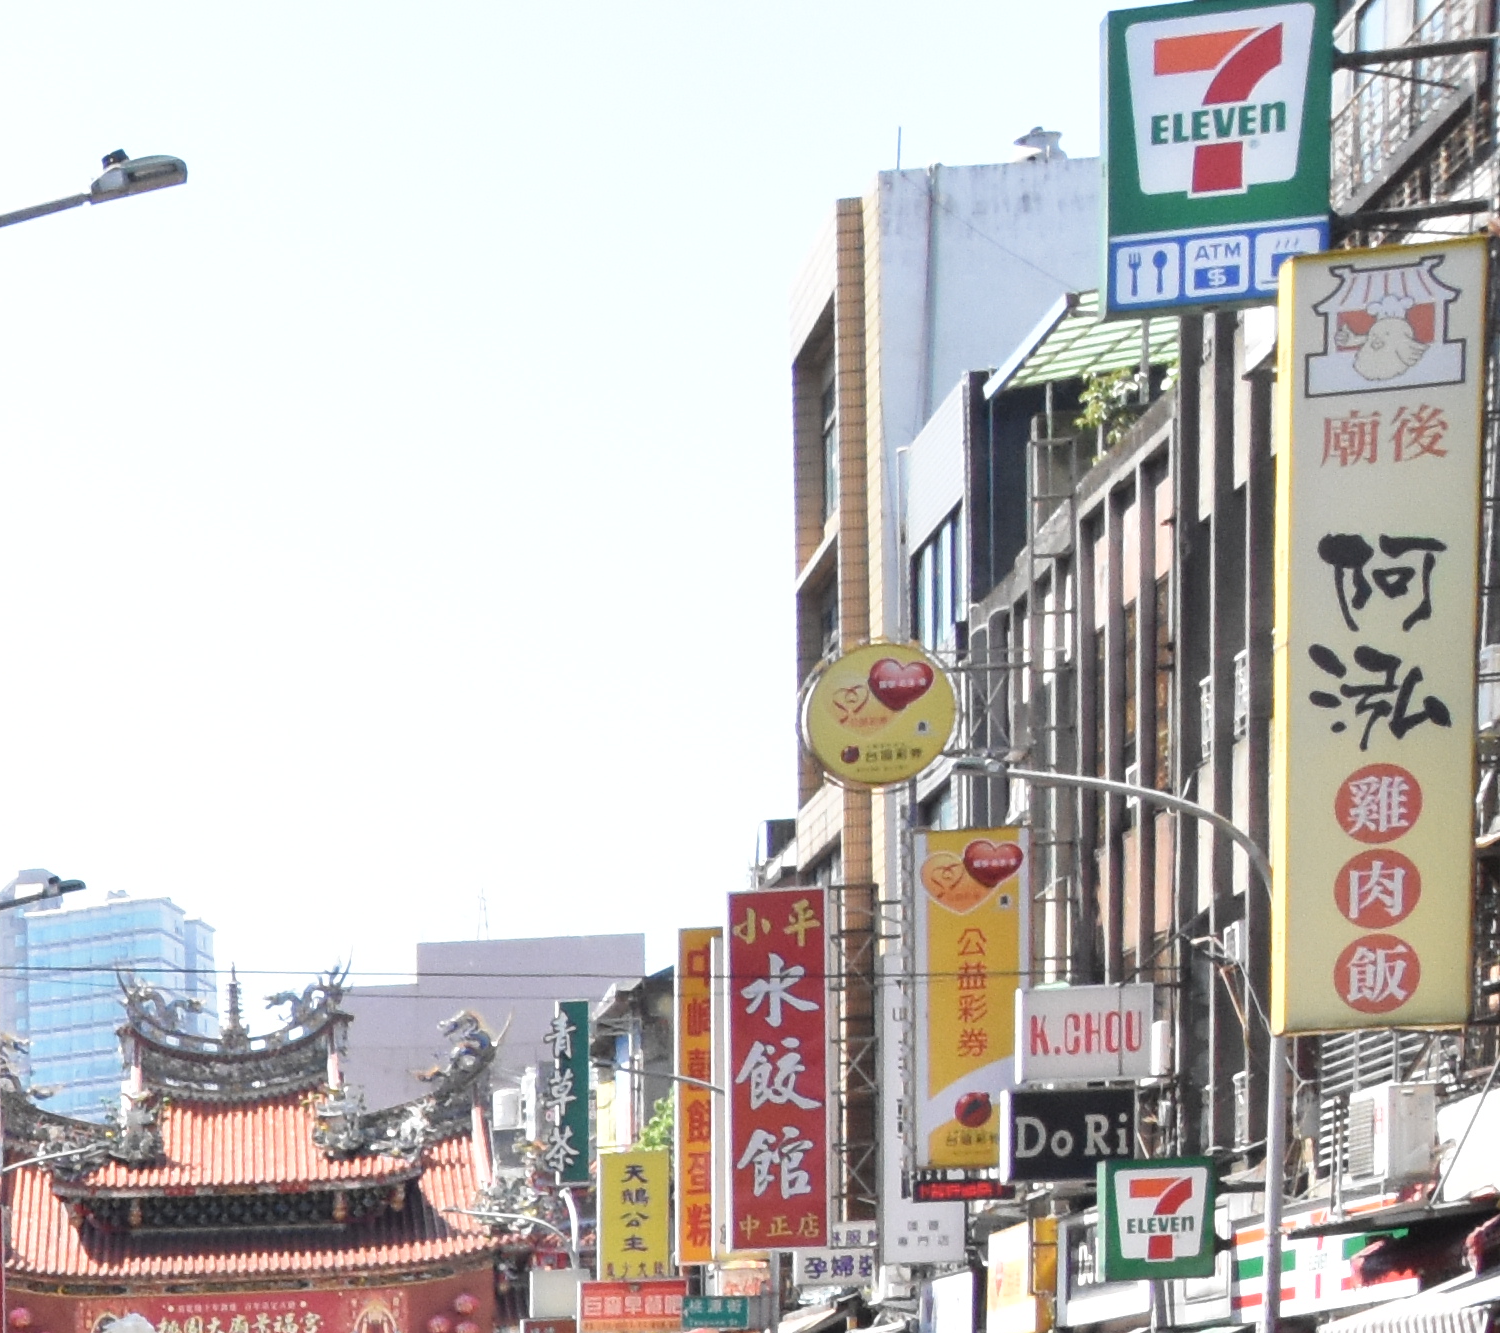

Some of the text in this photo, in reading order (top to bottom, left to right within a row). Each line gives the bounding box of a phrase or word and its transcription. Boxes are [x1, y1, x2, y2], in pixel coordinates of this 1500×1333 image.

[1195, 242, 1242, 263] ATM
[1321, 404, 1450, 470] 廟後
[1344, 772, 1413, 1006] 雞肉飯
[732, 899, 822, 947] 小平
[957, 927, 988, 1058] 公益彩券
[1030, 1010, 1143, 1057] K.CHOU
[545, 1005, 580, 1173] 青草茶
[735, 952, 822, 1200] 水餃館
[1015, 1112, 1130, 1159] Do Ri
[620, 1164, 649, 1252] 天鵝公主
[738, 1212, 821, 1241] 中正店
